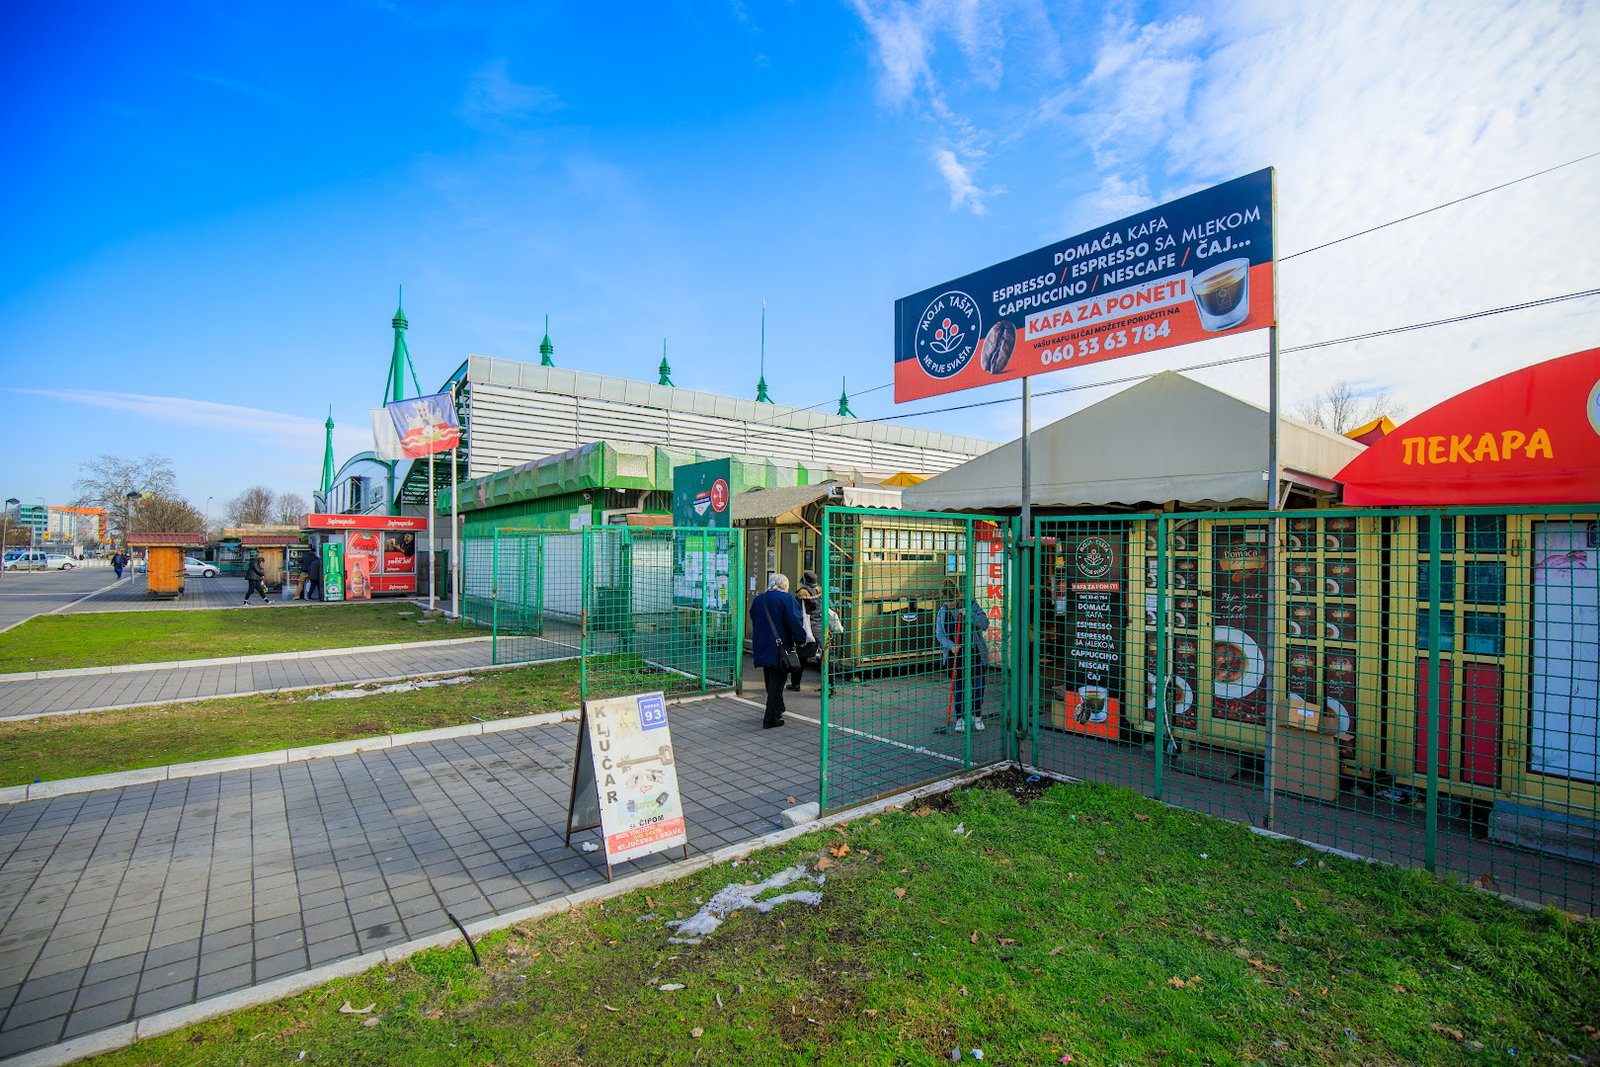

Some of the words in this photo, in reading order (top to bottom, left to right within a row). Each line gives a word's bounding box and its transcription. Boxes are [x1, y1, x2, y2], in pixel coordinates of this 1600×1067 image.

[993, 272, 1056, 302] ESPRESSO
[1072, 242, 1149, 278] ESPRESSO
[1155, 233, 1176, 252] SA
[1182, 205, 1260, 244] MLEKOM
[1054, 232, 1122, 266] DOMAĆA
[1128, 216, 1168, 242] KAFA
[999, 280, 1087, 316] CAPPUCCINO
[1103, 252, 1176, 286] NESCAFE
[1196, 236, 1250, 258] ČAJ...
[922, 301, 944, 331] MOJA
[950, 296, 974, 318] TAŠTA
[1029, 310, 1074, 334] KAFA
[1077, 302, 1102, 322] ZA
[1106, 278, 1186, 314] PONETI
[1033, 339, 1050, 349] VAŠU
[1052, 335, 1070, 345] KAFU
[1080, 328, 1093, 338] ČAJ
[1095, 320, 1126, 334] MOŽETE
[1128, 310, 1166, 326] PORUČITI
[1167, 306, 1180, 316] NA
[1040, 344, 1074, 366] 060
[1078, 337, 1099, 357] 33
[1104, 330, 1128, 351] 63
[1132, 320, 1170, 344] 784
[923, 355, 932, 367] NE
[931, 363, 945, 373] PIJE
[946, 346, 972, 372] SVAŠTA
[1401, 428, 1554, 466] ПЕКАРА
[988, 542, 1004, 662] PEKARA
[1076, 632, 1112, 641] ESPRESSO
[1077, 621, 1112, 630] ESPRESSO
[1071, 650, 1118, 661] CAPPUCCINO
[1078, 661, 1109, 671] NESCAFE
[645, 709, 661, 721] 93
[594, 706, 618, 804] KLJUČAR
[639, 815, 664, 826] ČIPOM
